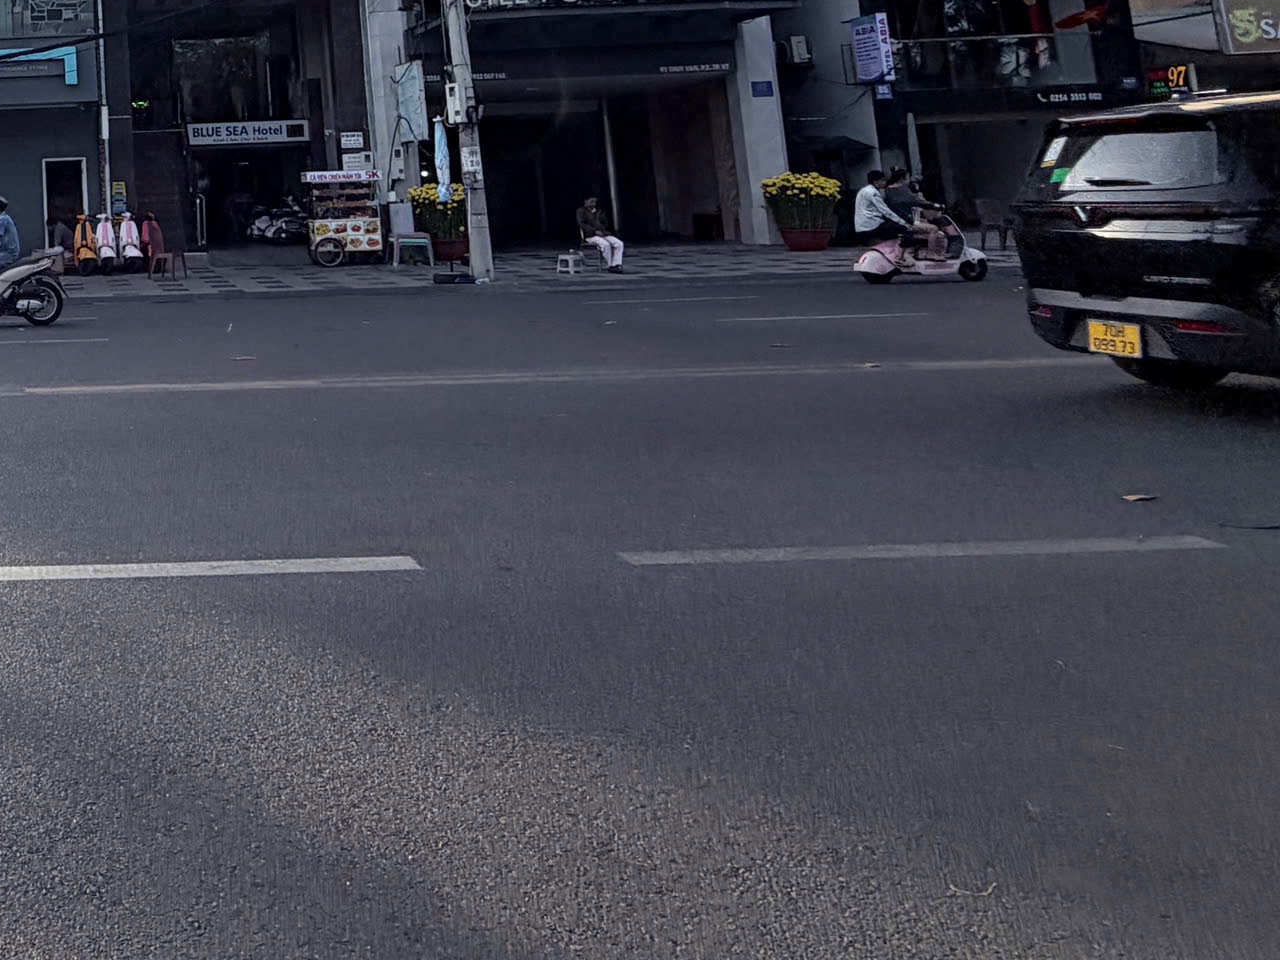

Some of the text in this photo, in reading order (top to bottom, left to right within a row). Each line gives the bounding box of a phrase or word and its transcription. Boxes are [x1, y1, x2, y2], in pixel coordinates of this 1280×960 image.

[1260, 19, 1280, 39] S
[1167, 66, 1187, 88] 97
[192, 124, 283, 138] BLUE SEA Hotel
[364, 170, 380, 180] 5K
